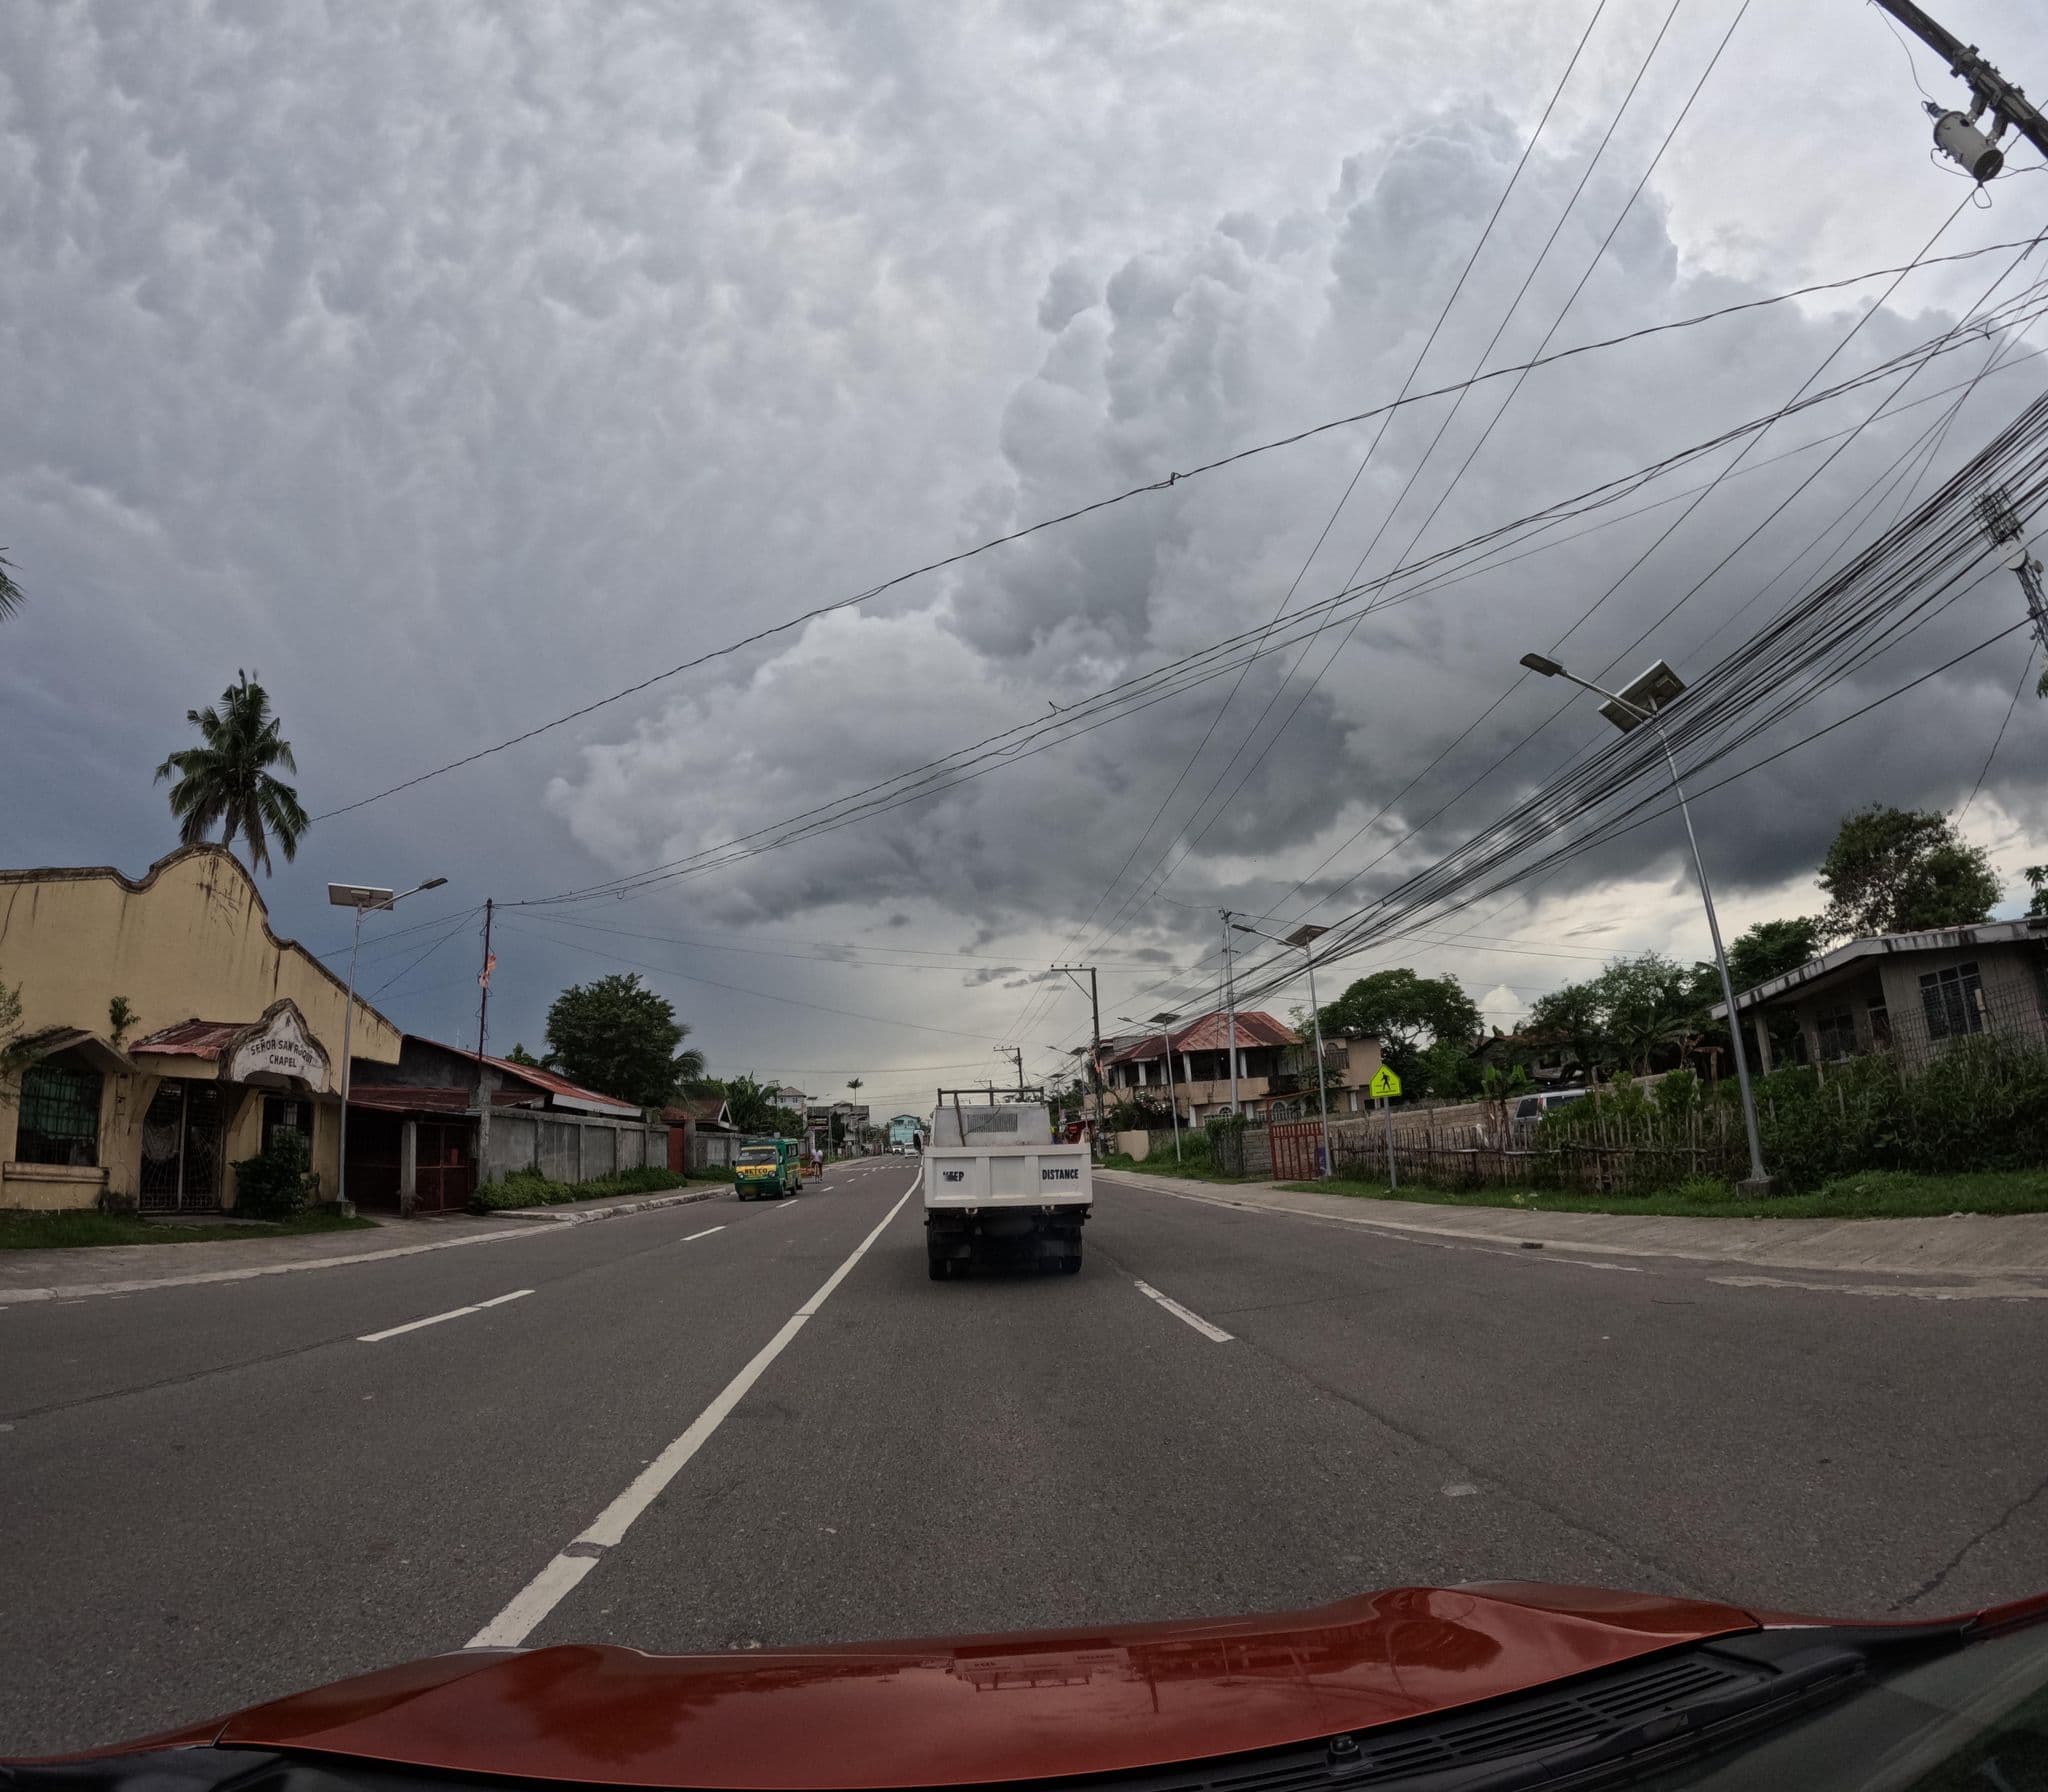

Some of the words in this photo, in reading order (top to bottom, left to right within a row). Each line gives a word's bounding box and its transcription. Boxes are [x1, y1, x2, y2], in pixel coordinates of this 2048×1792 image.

[250, 1039, 276, 1056] SEÑOR
[278, 1041, 292, 1052] SAN
[269, 1054, 296, 1068] CHAPEL
[1042, 1169, 1079, 1180] DISTANCE
